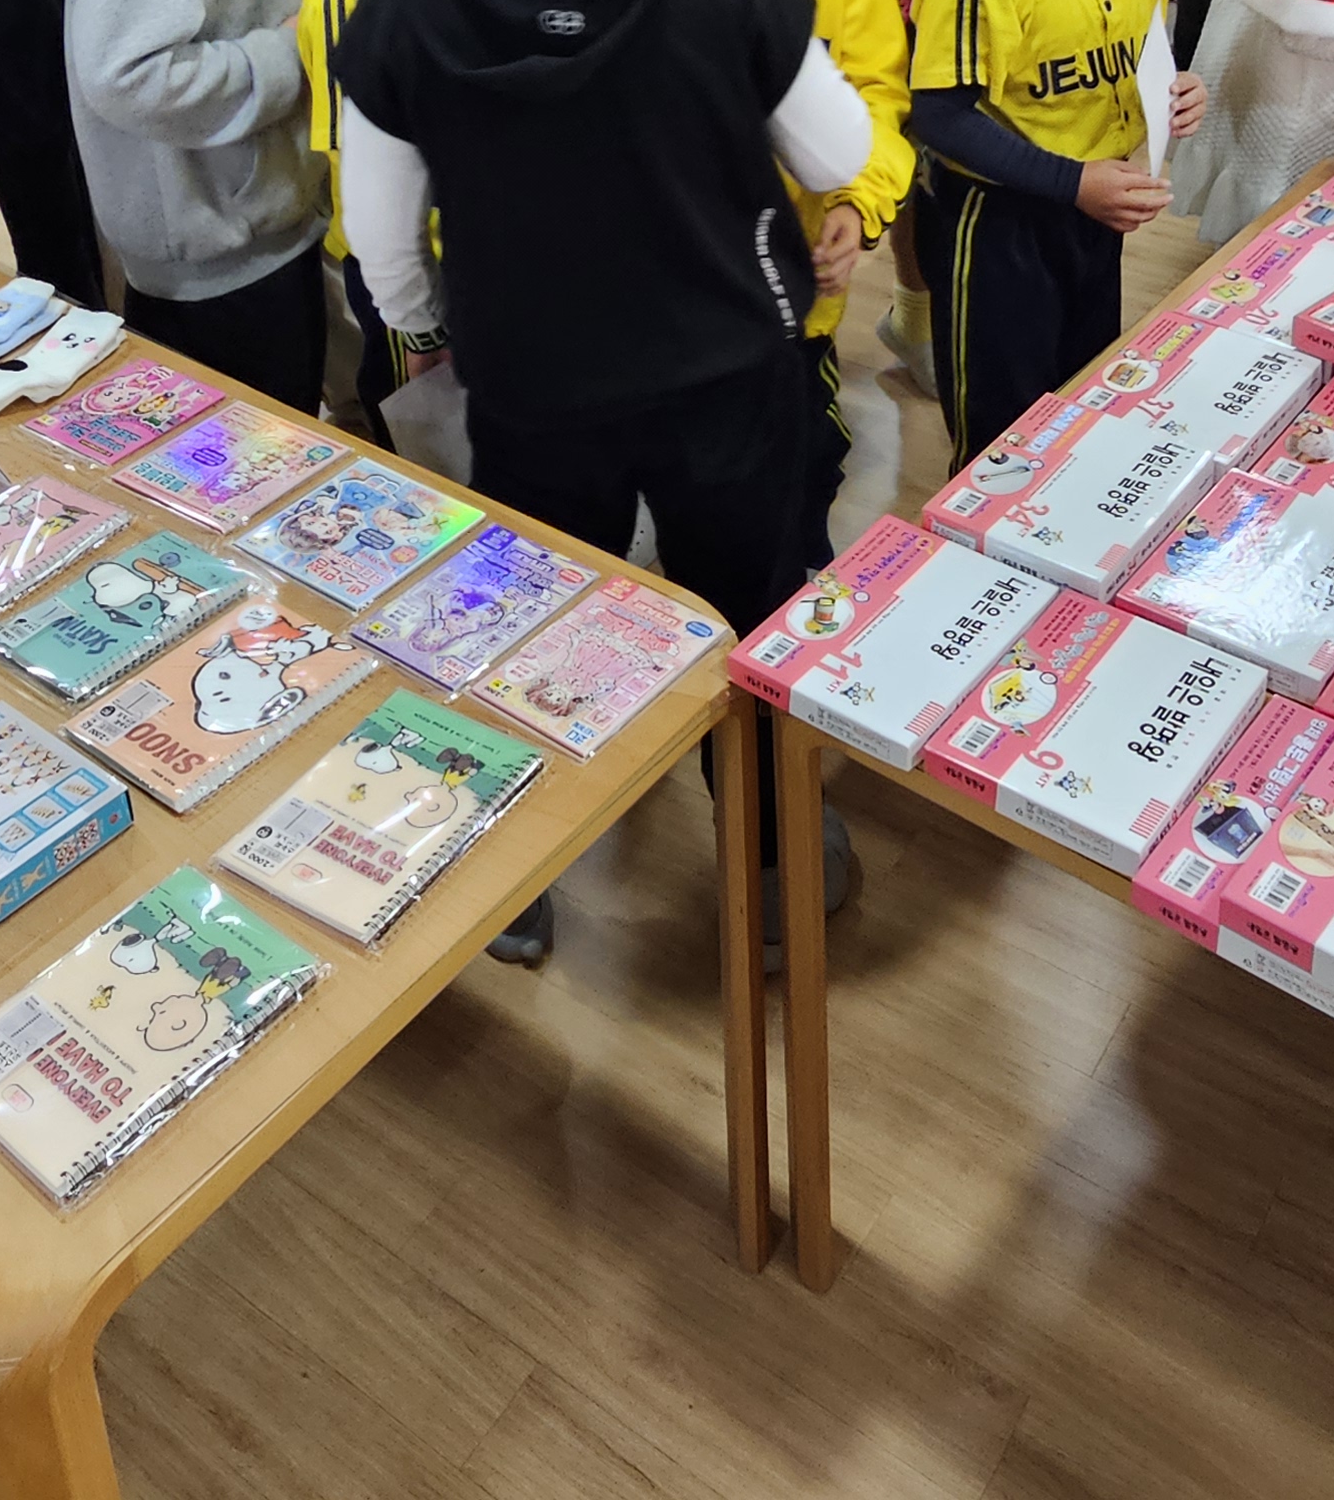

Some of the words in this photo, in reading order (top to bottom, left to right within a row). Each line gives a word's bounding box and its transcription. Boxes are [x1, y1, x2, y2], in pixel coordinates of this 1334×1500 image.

[1028, 33, 1147, 100] JEJUN
[1244, 349, 1293, 384] 내일은
[1213, 378, 1260, 419] 발명왕
[1133, 443, 1183, 481] 내일은
[1003, 500, 1049, 532] 34
[1096, 474, 1147, 522] 발명왕
[971, 576, 1025, 619] 내일은
[928, 611, 986, 664] 발명왕
[815, 652, 865, 682] 11
[825, 677, 841, 694] KIT
[1166, 658, 1226, 708] 내일은
[1126, 702, 1188, 765] 발명왕
[1025, 750, 1065, 772] 9
[1034, 770, 1051, 788] KIT
[313, 836, 394, 885] EVERYONE
[329, 823, 382, 860] HAVE
[377, 848, 406, 872] TO
[55, 1033, 110, 1088] HAVE
[33, 1051, 111, 1124] EVERYONE
[99, 1073, 134, 1106] TO
